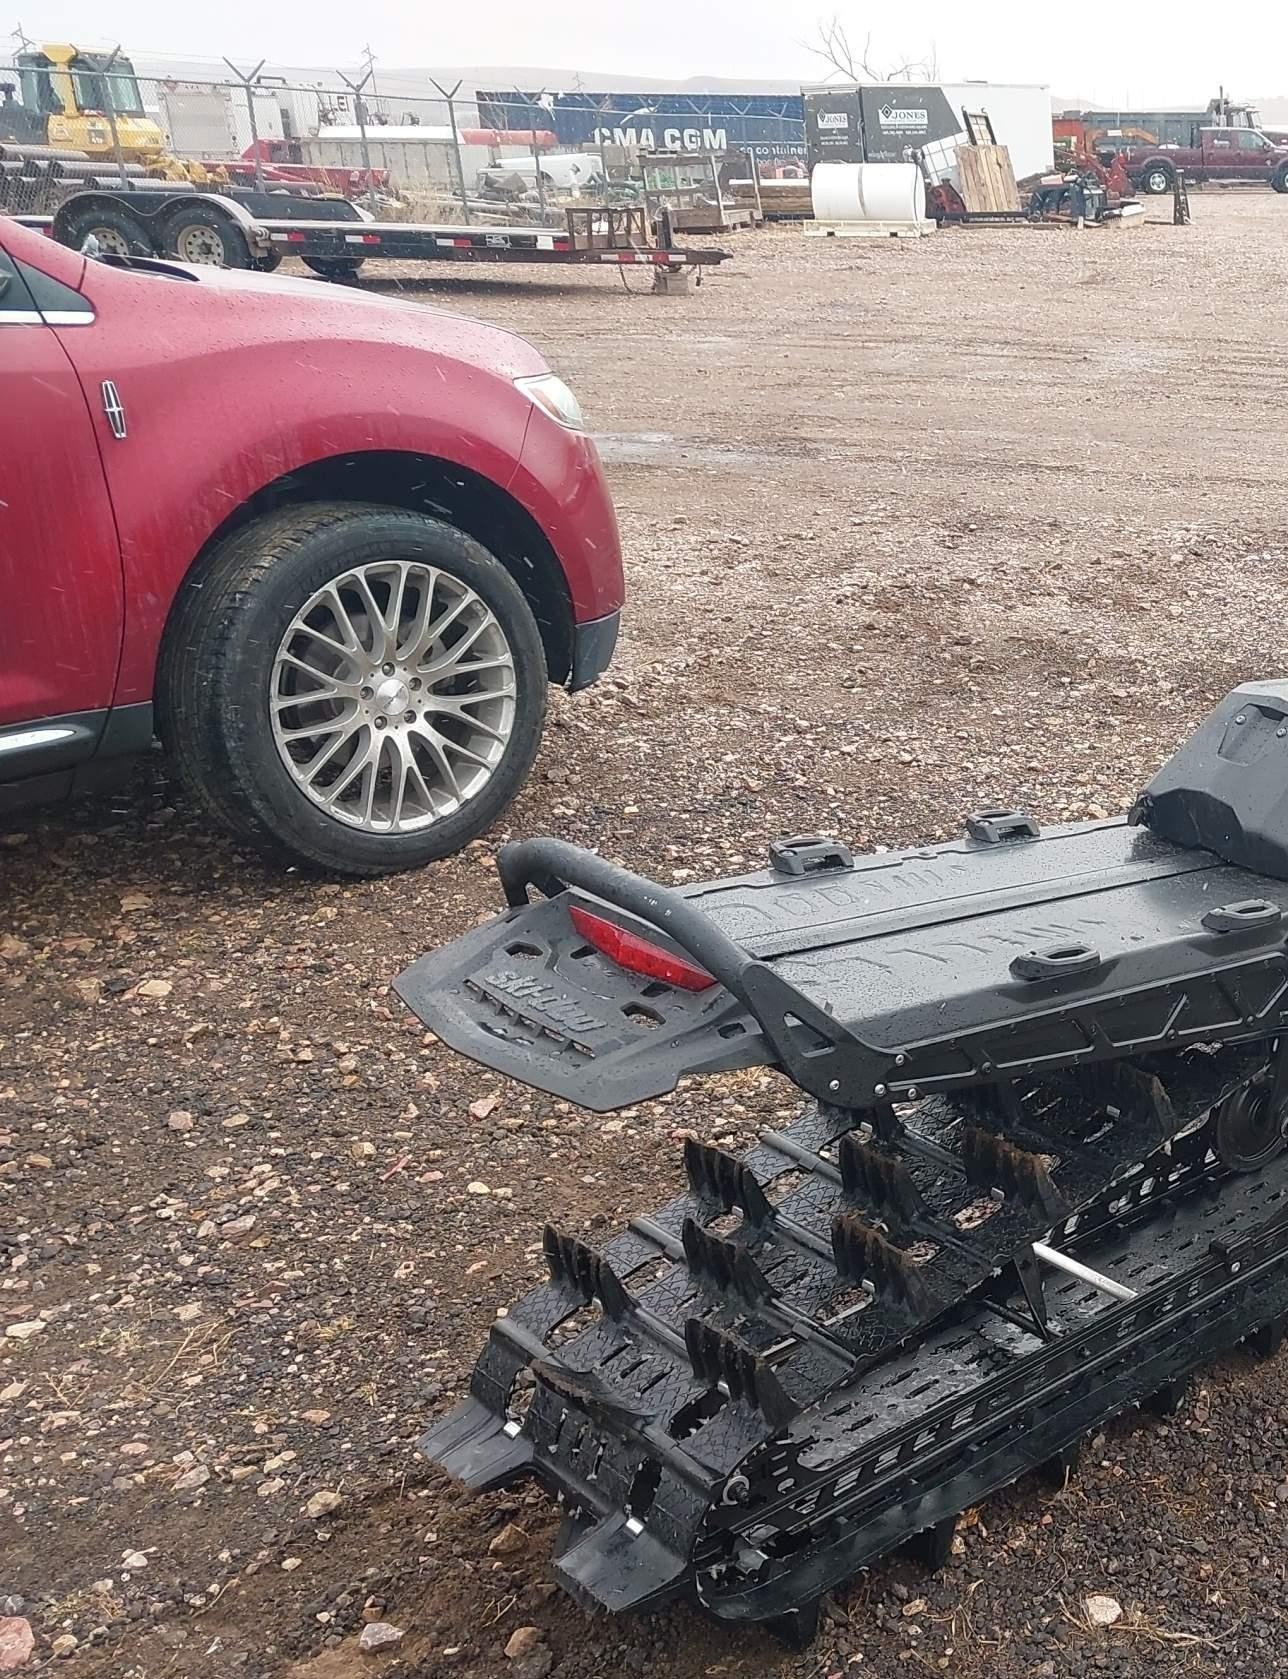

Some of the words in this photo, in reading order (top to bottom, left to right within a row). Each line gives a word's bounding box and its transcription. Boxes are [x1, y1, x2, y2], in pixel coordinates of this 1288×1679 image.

[892, 111, 926, 120] JONES
[593, 128, 655, 150] CMA
[664, 128, 727, 150] CGM
